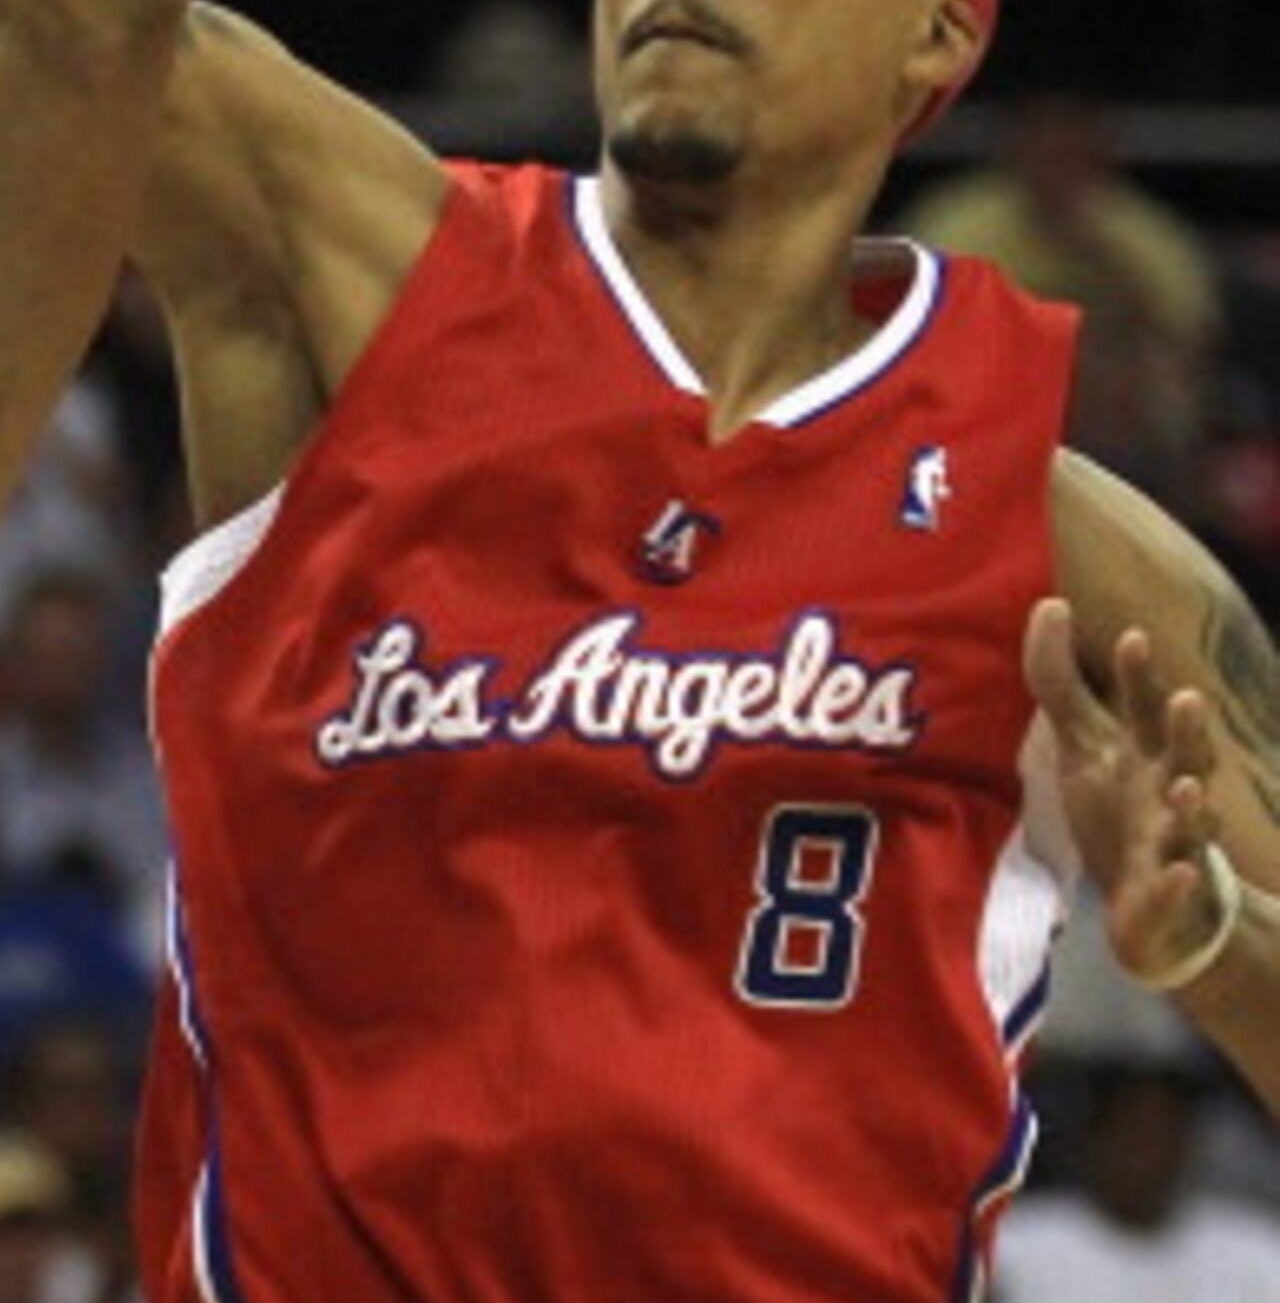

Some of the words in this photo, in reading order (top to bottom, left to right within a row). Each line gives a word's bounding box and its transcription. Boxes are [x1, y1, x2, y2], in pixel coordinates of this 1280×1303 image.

[317, 619, 496, 763] Los
[509, 611, 916, 777] Angeles
[733, 802, 880, 1012] 8
